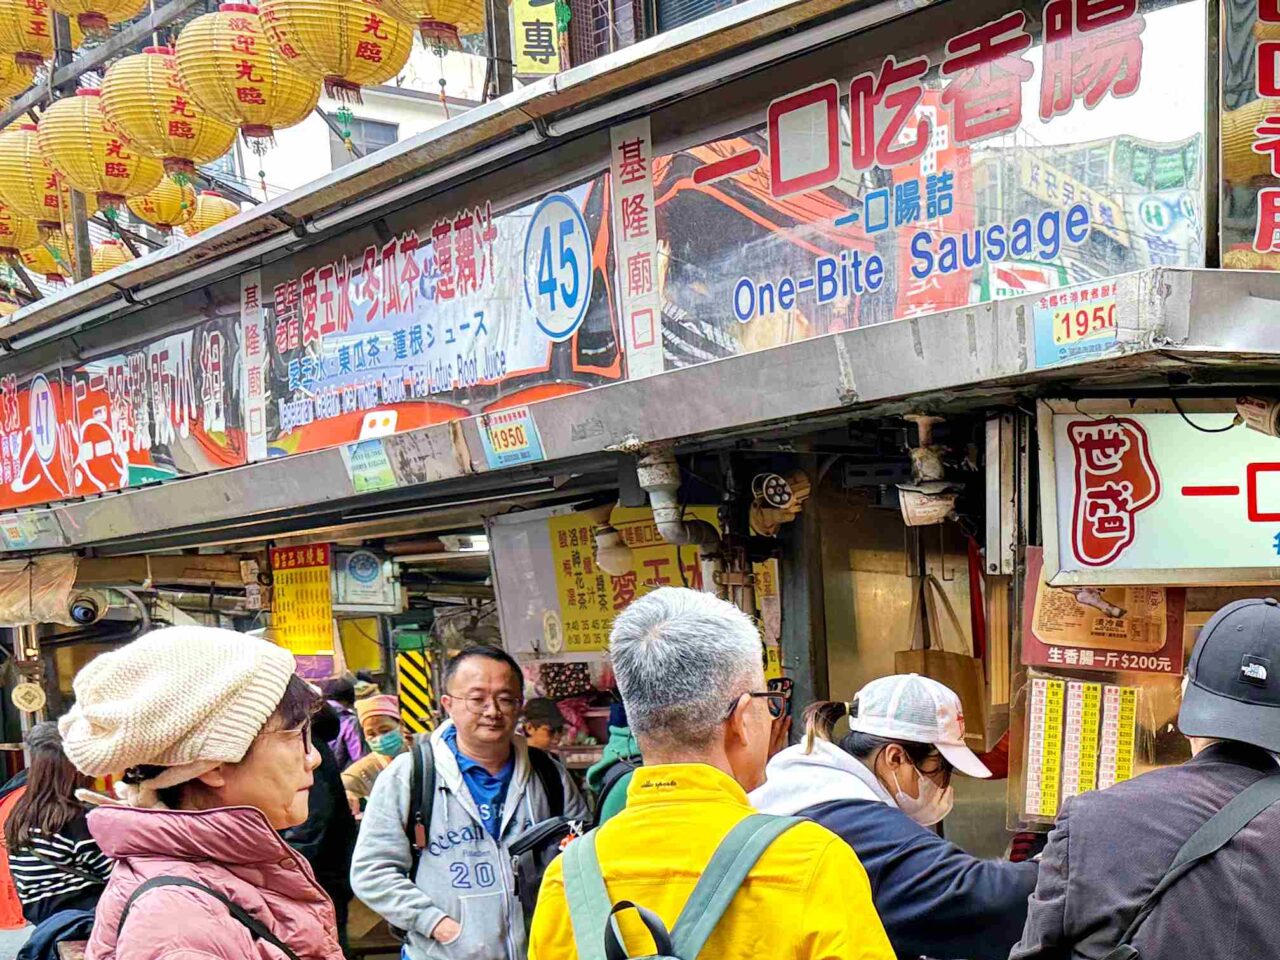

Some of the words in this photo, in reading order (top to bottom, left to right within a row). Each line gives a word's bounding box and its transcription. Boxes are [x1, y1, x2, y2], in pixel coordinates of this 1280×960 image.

[692, 0, 1145, 199] 一口吃香腸
[616, 137, 656, 351] 基隆廟口
[833, 170, 955, 237] 一口腸詰
[537, 217, 578, 312] 45
[734, 248, 885, 323] One-Bite
[910, 202, 1091, 281] Sausage
[35, 390, 50, 447] 47
[492, 425, 526, 450] 1950
[449, 861, 496, 889] 20
